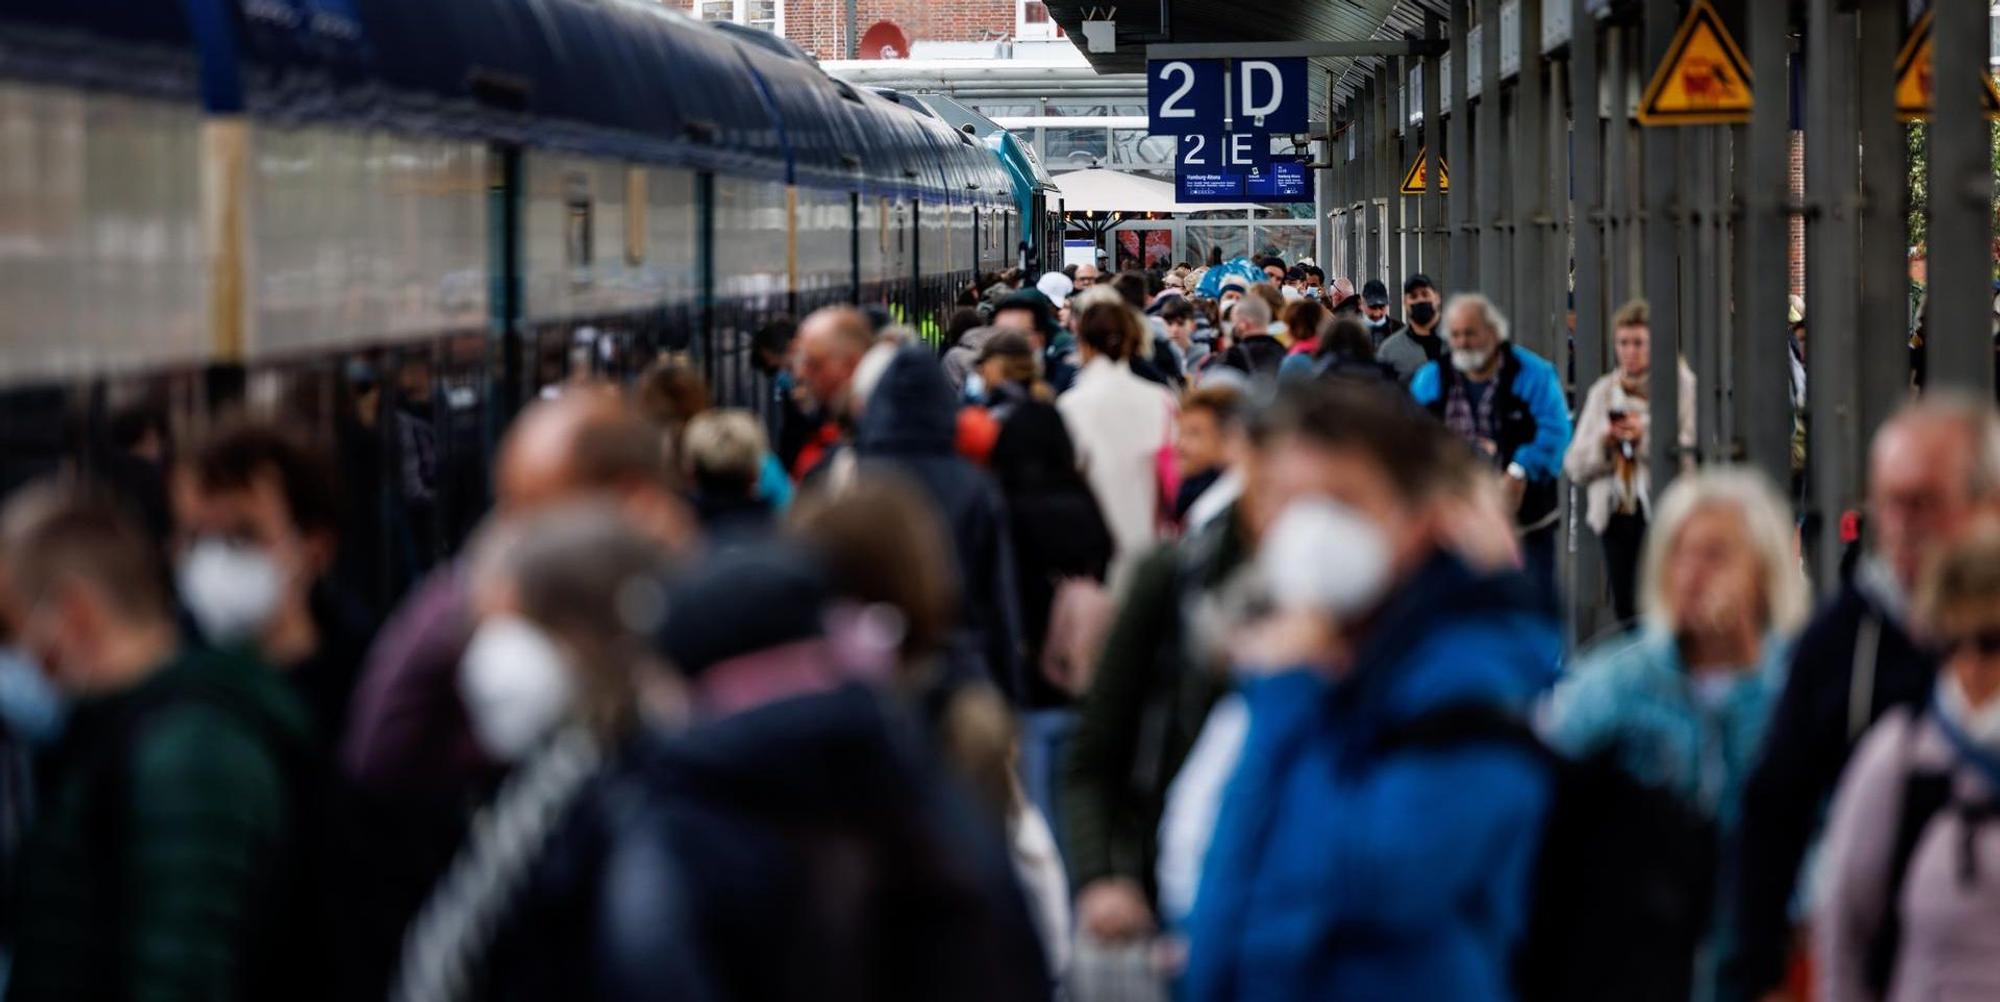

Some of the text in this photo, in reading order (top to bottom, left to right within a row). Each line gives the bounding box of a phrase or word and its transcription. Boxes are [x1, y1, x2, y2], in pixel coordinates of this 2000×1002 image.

[1159, 61, 1284, 118] 2 D
[1184, 134, 1253, 165] 2 E
